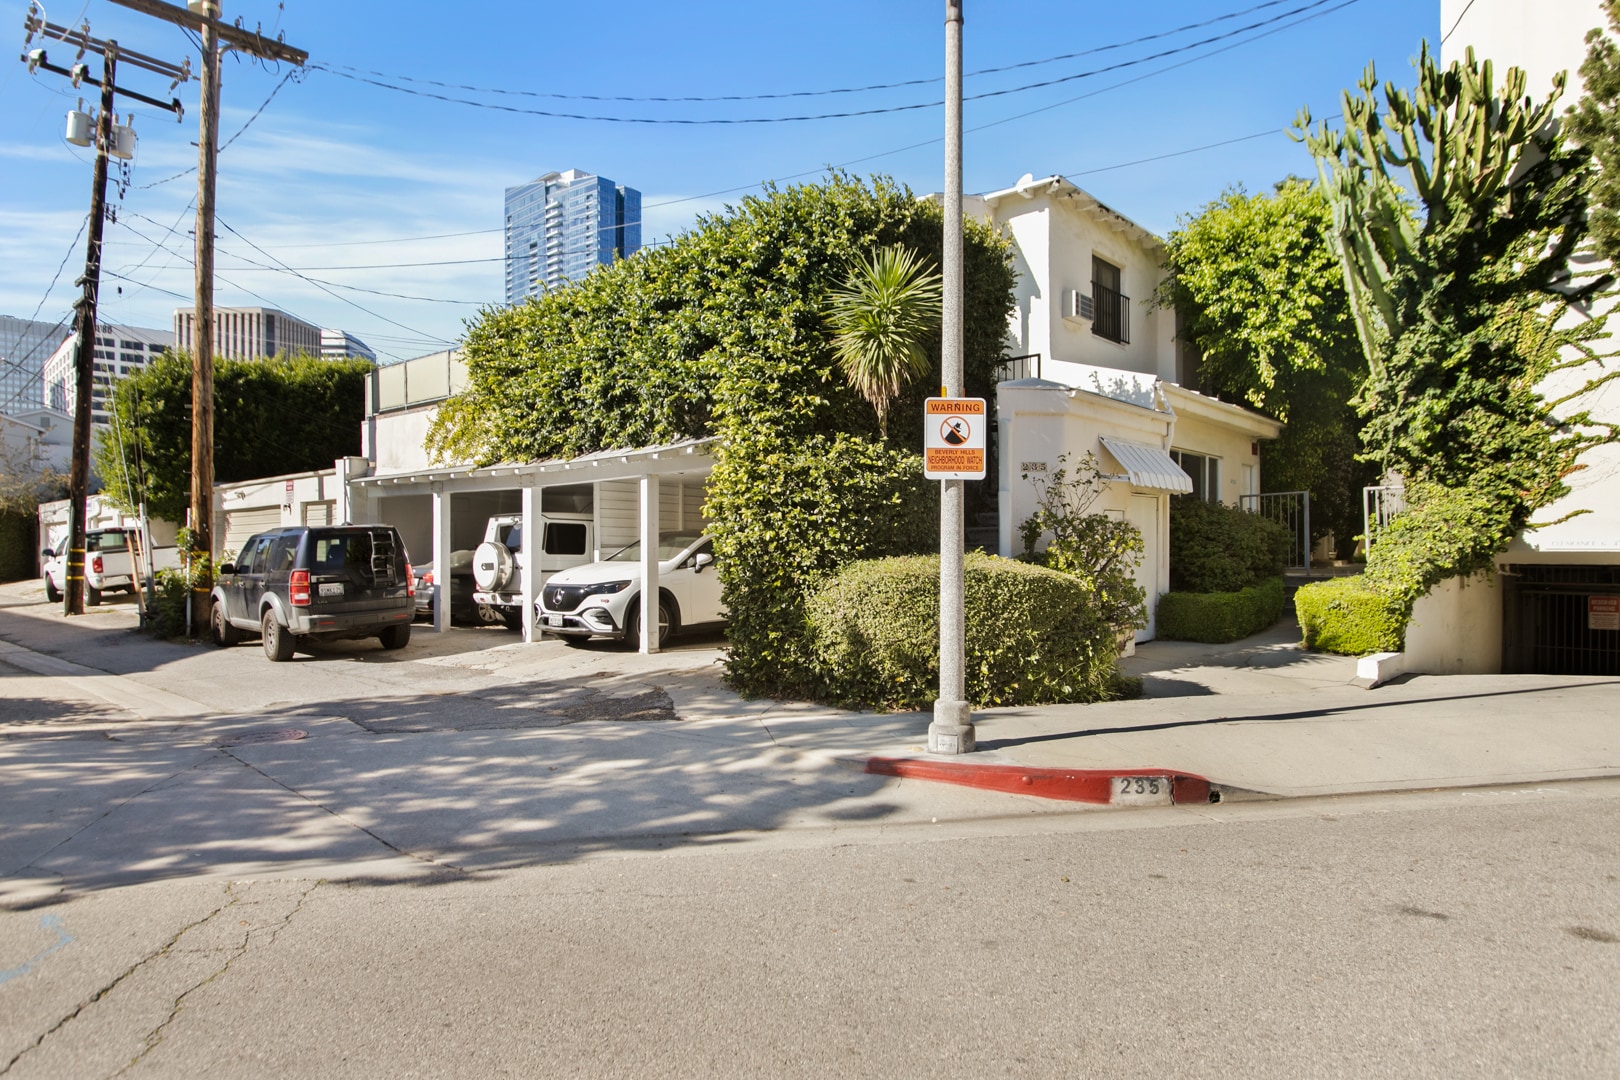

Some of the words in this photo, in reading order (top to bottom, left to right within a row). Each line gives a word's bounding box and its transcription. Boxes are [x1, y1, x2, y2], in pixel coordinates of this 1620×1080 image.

[931, 403, 980, 412] WARNING
[928, 456, 964, 464] NEIGHBORHOOD
[967, 457, 983, 465] WATCH
[1022, 463, 1046, 471] 235
[1120, 779, 1160, 794] 235
